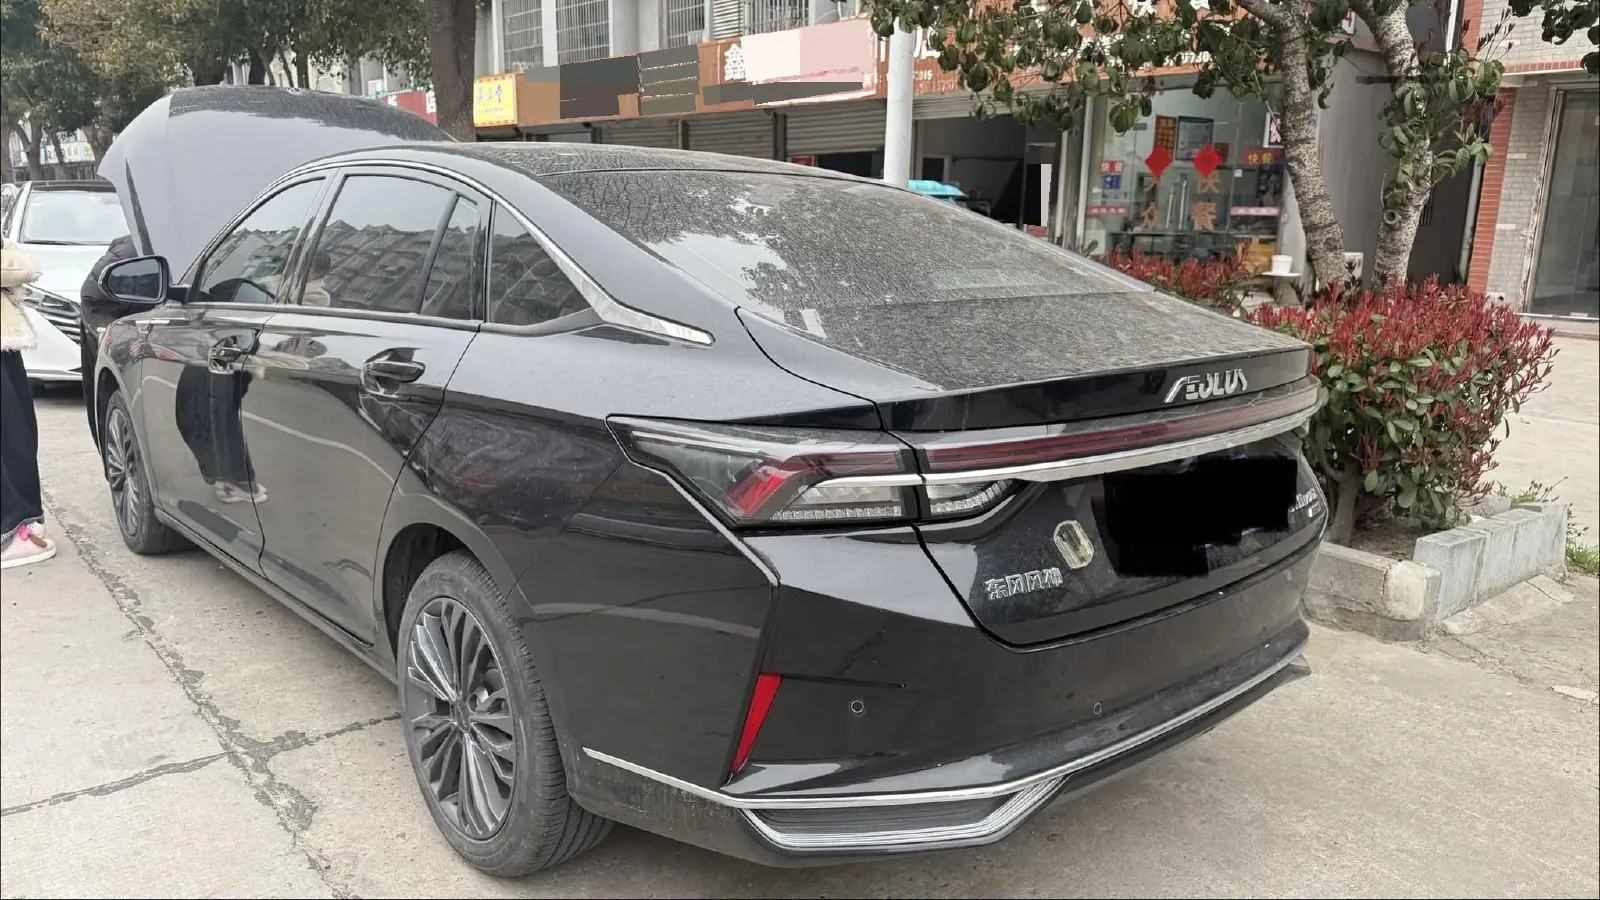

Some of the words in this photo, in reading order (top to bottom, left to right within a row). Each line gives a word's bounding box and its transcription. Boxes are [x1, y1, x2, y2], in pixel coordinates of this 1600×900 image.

[1248, 152, 1273, 164] 快餐
[983, 567, 1063, 600] 东风风神
